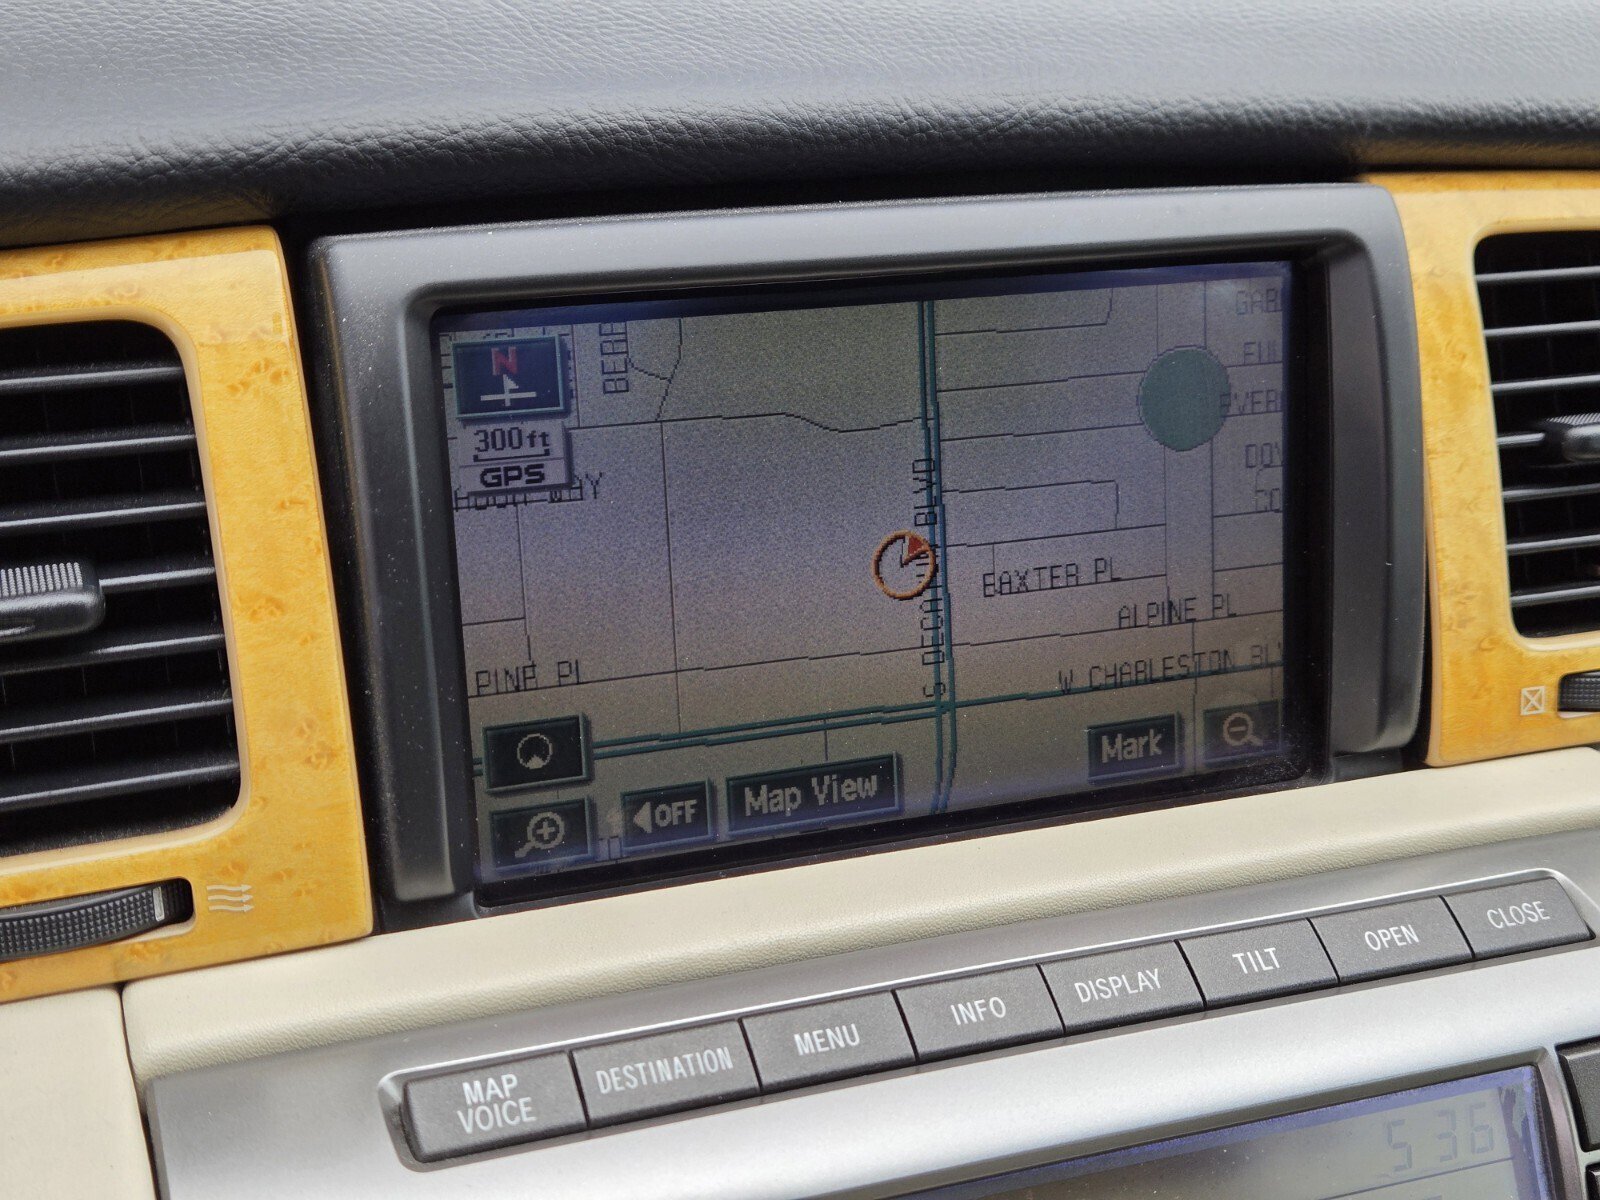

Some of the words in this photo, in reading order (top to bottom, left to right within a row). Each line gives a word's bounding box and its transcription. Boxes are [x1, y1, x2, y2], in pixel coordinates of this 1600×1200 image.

[491, 346, 517, 376] N
[473, 426, 550, 452] 300ft
[480, 463, 545, 488] GPS
[912, 458, 939, 527] BLVD
[983, 563, 1079, 598] BAXTER
[1094, 556, 1122, 583] PL
[1118, 597, 1197, 629] ALPINE
[1212, 593, 1237, 619] PL
[1058, 669, 1074, 695] W
[1088, 649, 1235, 690] CHARLESTON
[922, 682, 946, 698] S
[1101, 728, 1163, 764] Mark
[744, 783, 802, 817] Map
[811, 772, 879, 804] View
[654, 799, 698, 828] OFF
[1486, 900, 1551, 930] CLOSE
[1363, 923, 1420, 953] OPEN
[1231, 945, 1281, 976] TILT
[1073, 967, 1163, 1004] DISPLAY
[949, 996, 1008, 1028] INFO
[793, 1022, 861, 1057] MENU
[595, 1046, 734, 1095] DESTINATION
[461, 1073, 519, 1105] MAP
[456, 1096, 537, 1135] VOICE
